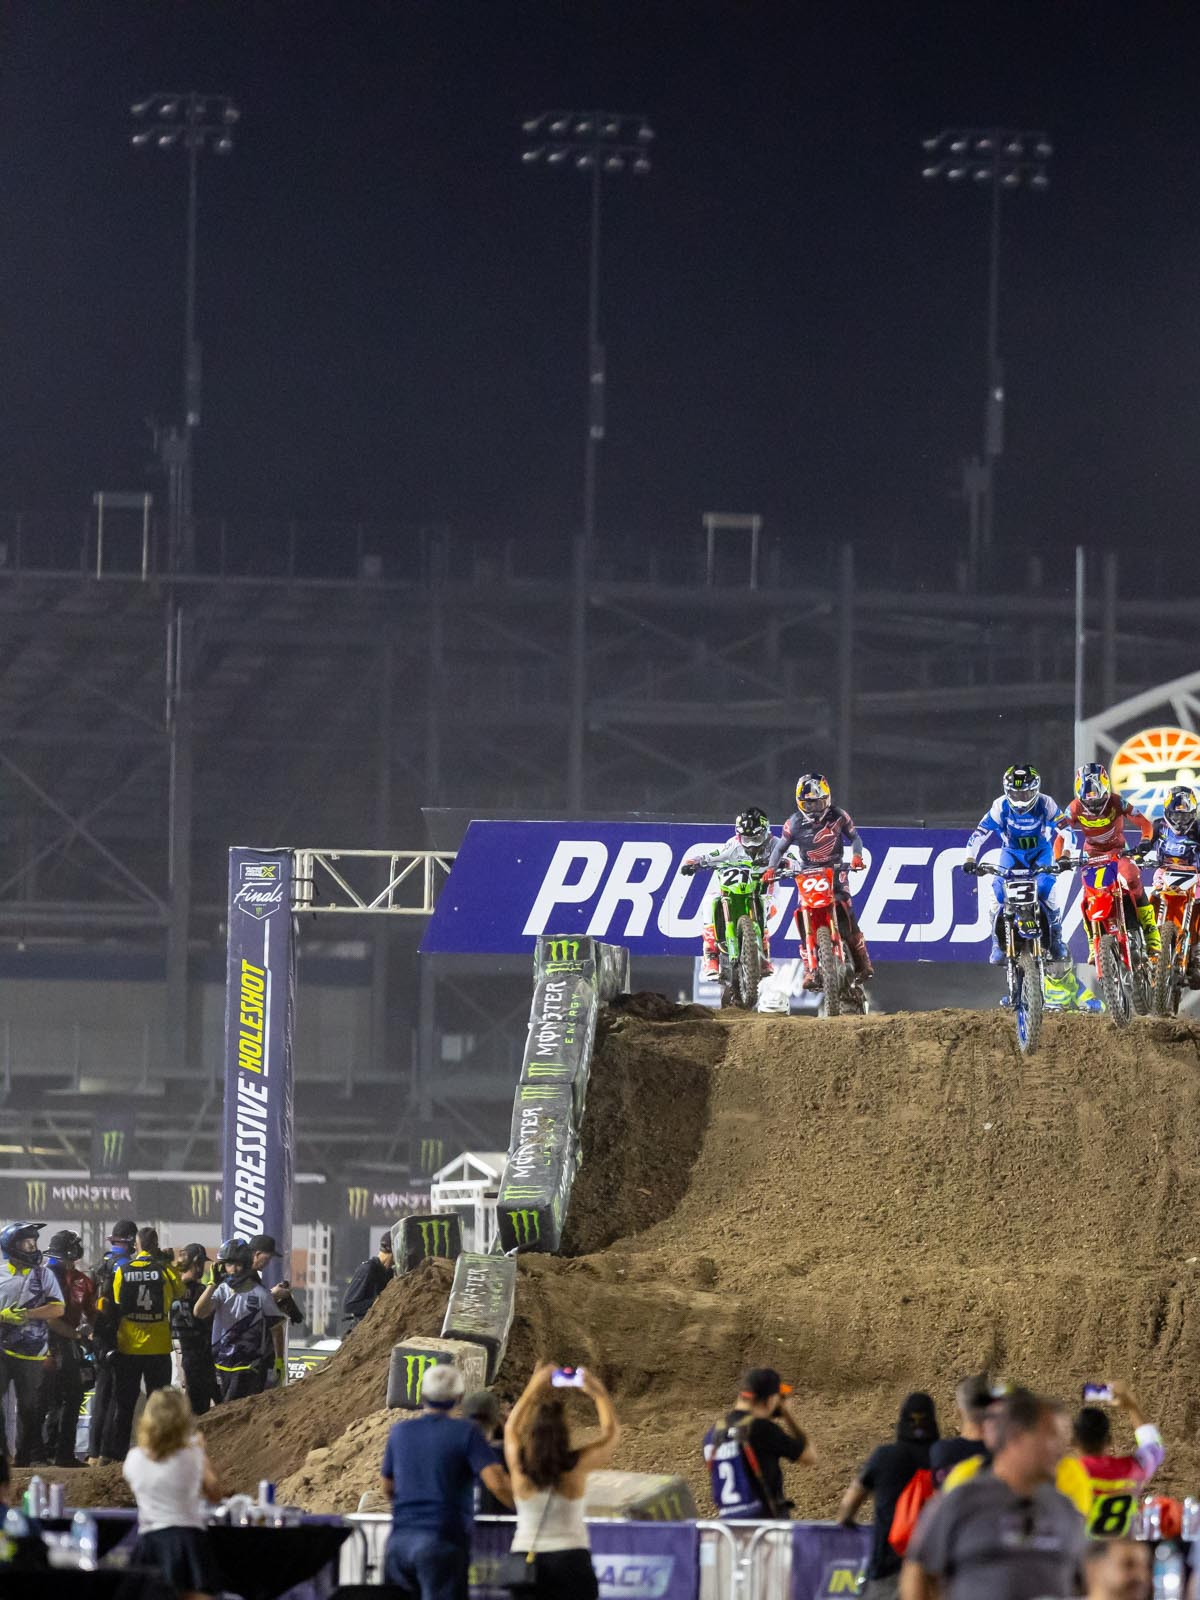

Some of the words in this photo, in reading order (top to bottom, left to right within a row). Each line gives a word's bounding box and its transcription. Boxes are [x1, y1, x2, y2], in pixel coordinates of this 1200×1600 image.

[723, 869, 750, 886] 21
[802, 878, 829, 892] 96
[1094, 867, 1106, 889] 1
[1170, 872, 1195, 887] 7
[233, 882, 283, 903] Finals
[1008, 882, 1034, 902] 3
[239, 959, 265, 1074] HOLESHOT
[535, 980, 567, 1056] MONSTER
[52, 1184, 132, 1202] MONSTER
[123, 1270, 159, 1282] VIDEO
[136, 1284, 153, 1311] 4
[718, 1461, 742, 1505] 2
[1090, 1495, 1132, 1535] 8
